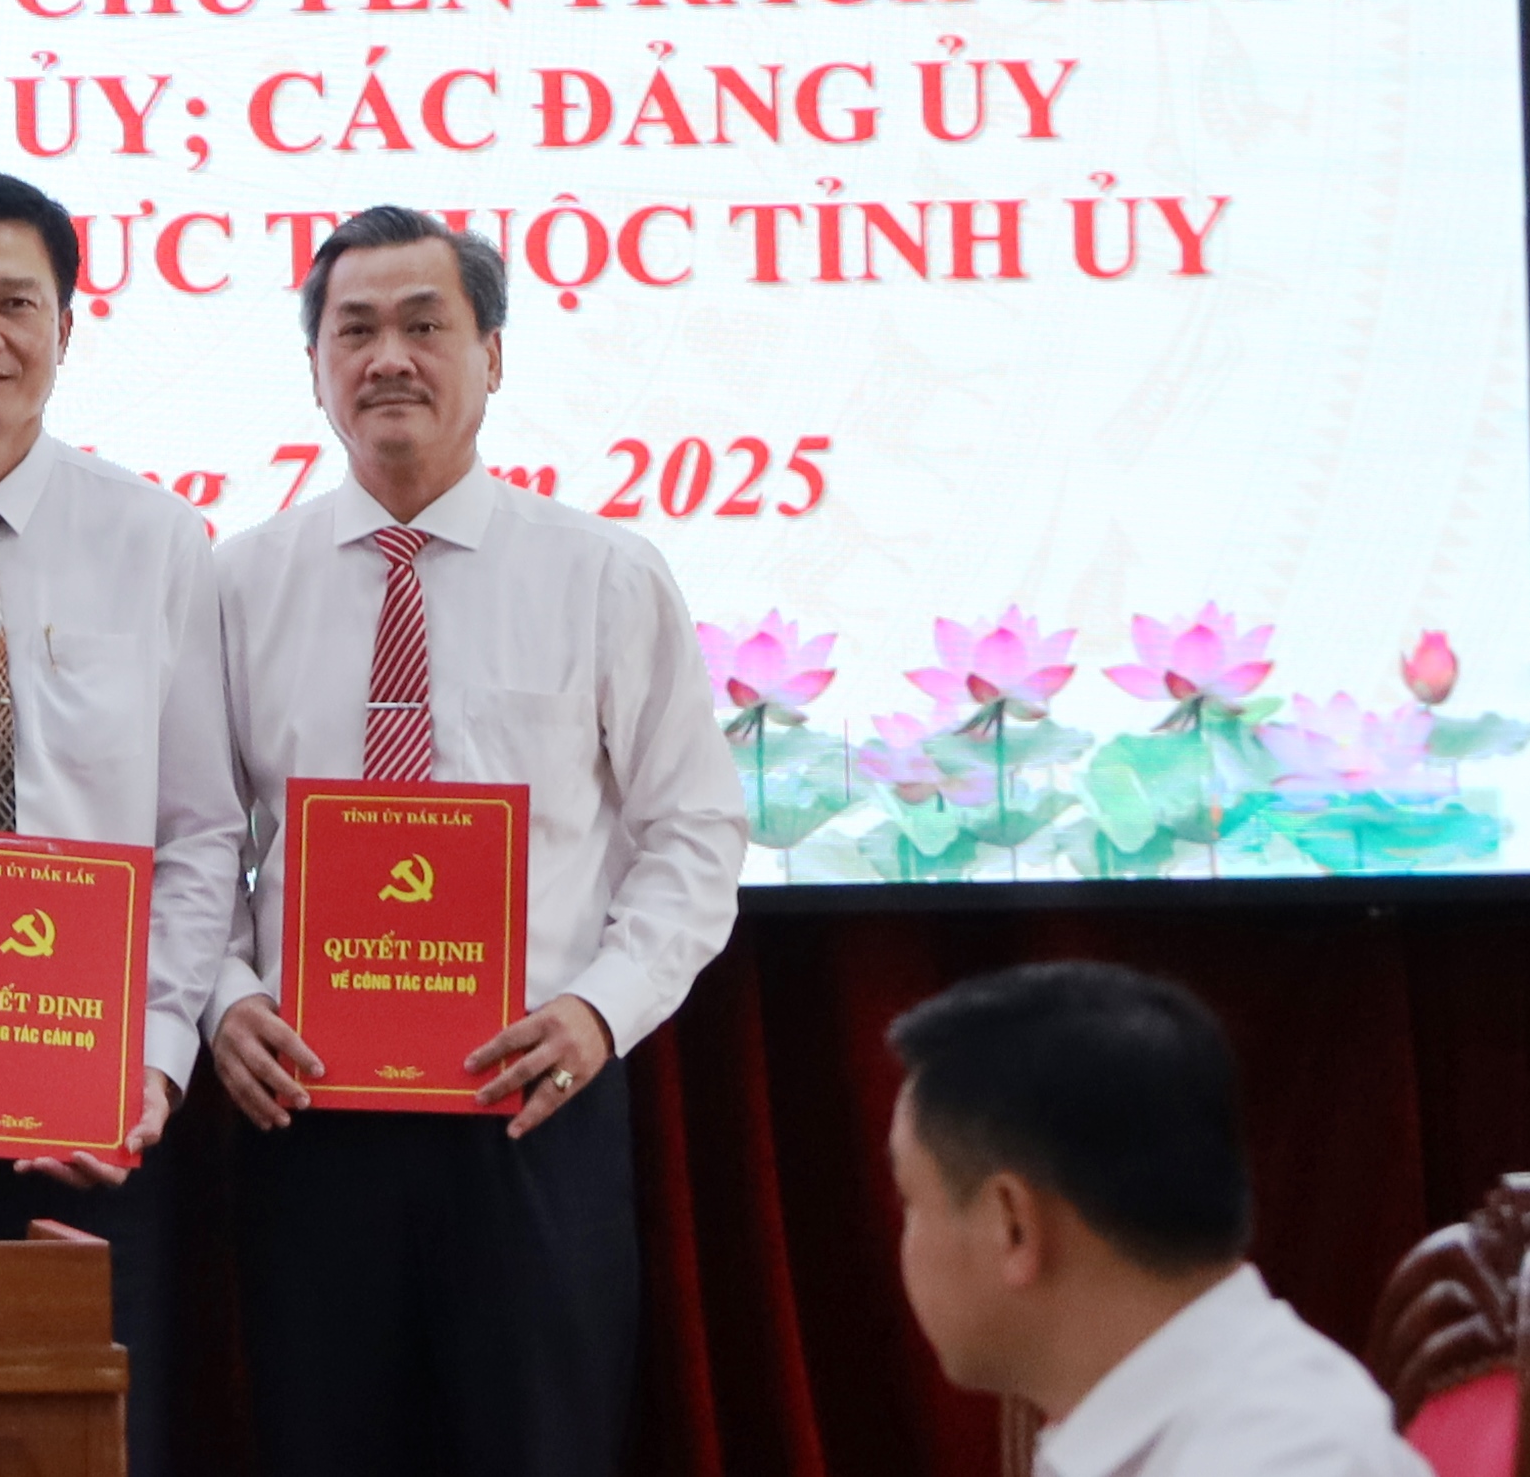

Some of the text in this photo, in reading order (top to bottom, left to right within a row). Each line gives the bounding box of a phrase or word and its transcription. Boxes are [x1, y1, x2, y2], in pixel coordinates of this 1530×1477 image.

[11, 52, 209, 168] ỦY;
[249, 47, 497, 153] CÁC
[536, 42, 877, 147] ĐẢNG
[916, 36, 1077, 141] ỦY
[267, 193, 693, 310] TỘC
[730, 178, 1026, 283] TỈNH
[1068, 173, 1229, 279] ỦY
[597, 436, 831, 518] 2025
[341, 807, 378, 823] TỈNH
[382, 808, 403, 824] ỦY
[6, 862, 27, 879] ỦY
[324, 930, 484, 966] QUYẾT ĐỊNH
[331, 969, 477, 995] VỀ CÔNG TÁC CÁN BỘ
[37, 994, 103, 1021] ĐỊNH
[13, 1024, 40, 1044] TÁC
[42, 1027, 73, 1047] CÁN
[74, 1029, 95, 1051] BỘ
